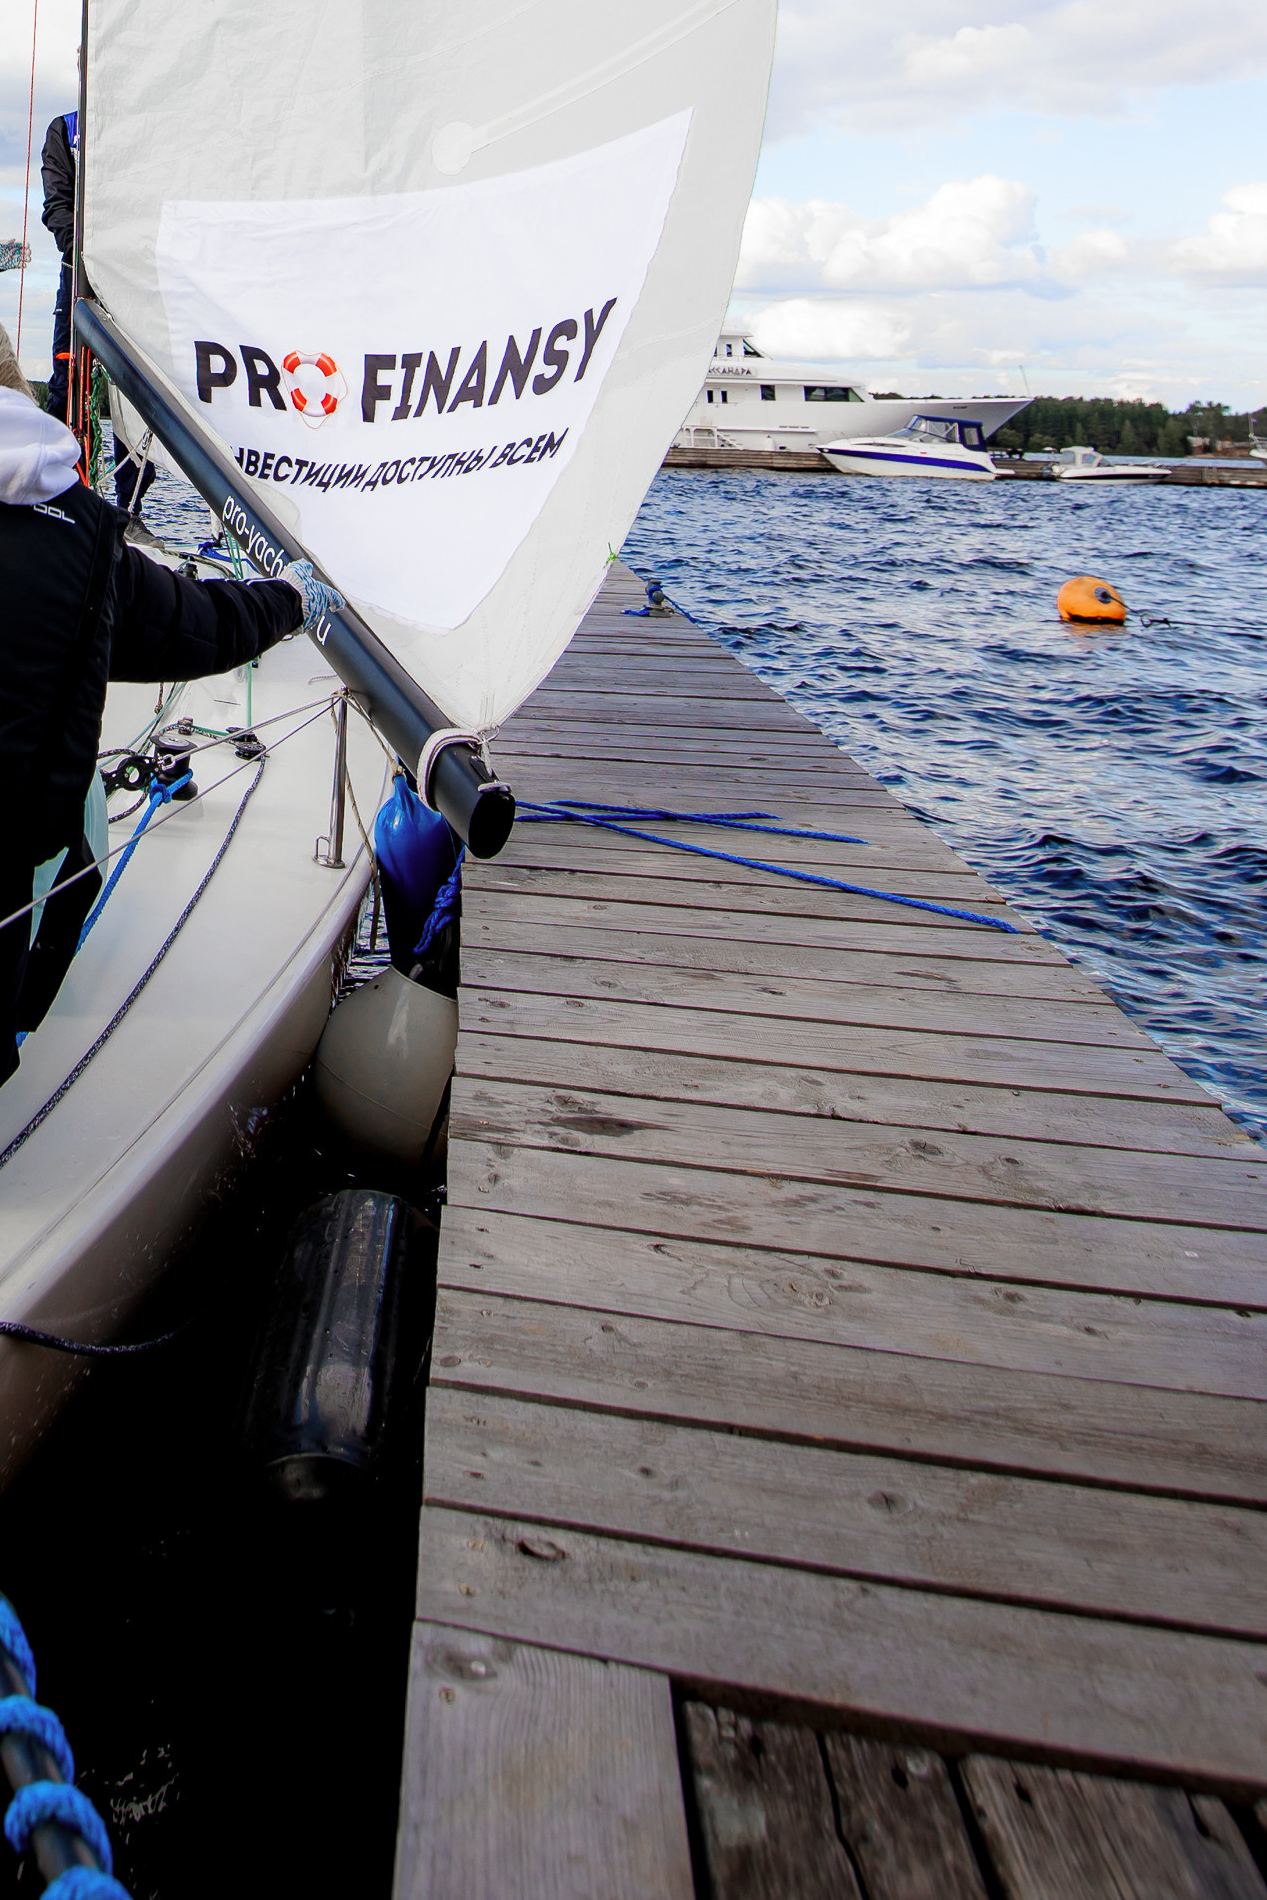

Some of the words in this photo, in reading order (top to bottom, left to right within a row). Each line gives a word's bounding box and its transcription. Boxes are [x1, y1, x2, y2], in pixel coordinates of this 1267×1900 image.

[361, 297, 617, 423] FINANSY
[230, 446, 371, 493] НВЕСТИЦИИ
[361, 448, 494, 492] ДОСТУПНЫ
[488, 427, 569, 469] ВСЕМ
[222, 495, 332, 646] pro-yachu
